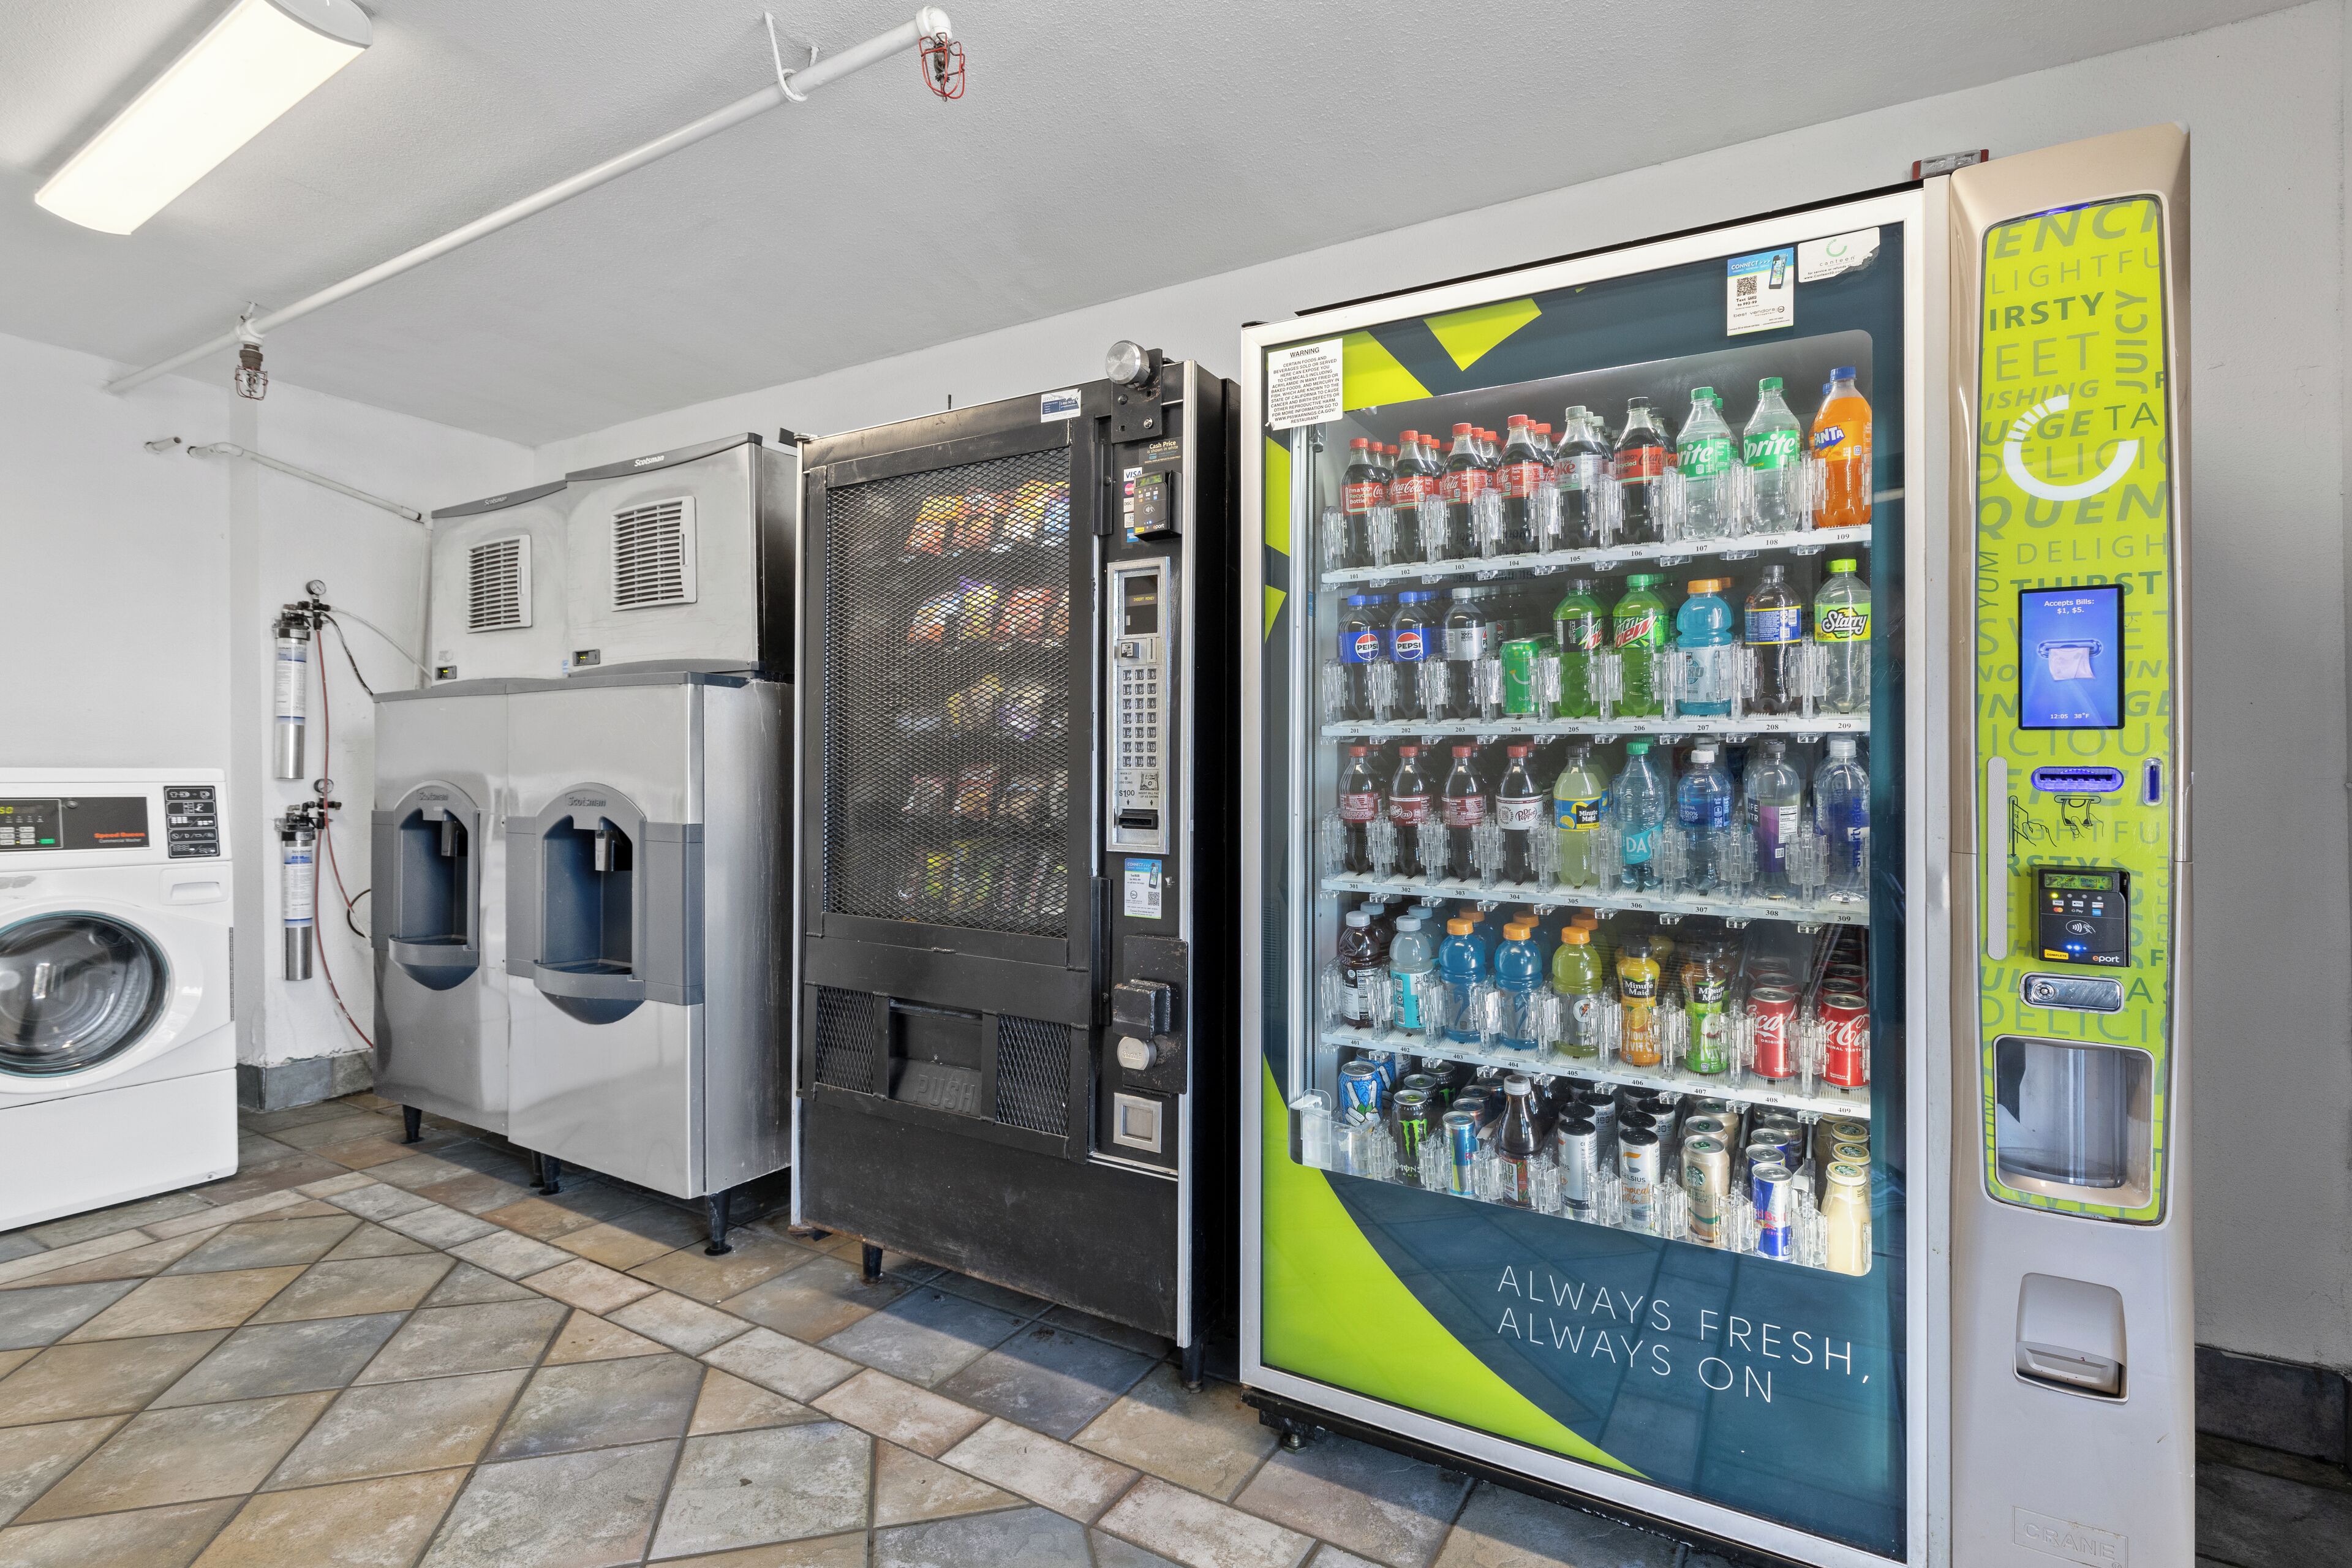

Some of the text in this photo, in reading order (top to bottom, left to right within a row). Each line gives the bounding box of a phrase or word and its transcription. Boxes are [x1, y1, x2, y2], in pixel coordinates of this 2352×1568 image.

[1731, 260, 1759, 270] CONNECT
[1819, 256, 1855, 266] canteen
[1989, 292, 2105, 331] IRSTY
[2115, 289, 2148, 394] JUICY
[1290, 347, 1319, 358] WARNING
[1284, 373, 1308, 382] CHEMICALS
[1272, 380, 1298, 388] ACRYLAMIDE
[1291, 391, 1316, 399] CALIFORNIA
[1289, 400, 1321, 409] REPRODUCTIVE
[1295, 404, 1323, 413] INFORMATION
[1744, 434, 1795, 464] Sprite
[634, 455, 665, 467] Scotsman
[1391, 479, 1424, 495] Coca-Cola
[484, 496, 507, 507] Scotsman
[1822, 611, 1867, 633] Starry
[568, 797, 606, 807] Scotsman
[1518, 810, 1536, 821] Pepper
[1621, 1171, 1646, 1183] CELSIUS
[1765, 1211, 1786, 1221] Bul
[1498, 1265, 1869, 1384] ALWAYS FRESH,
[1498, 1307, 1771, 1403] ALWAYS ON
[2022, 1523, 2116, 1561] CRANE
